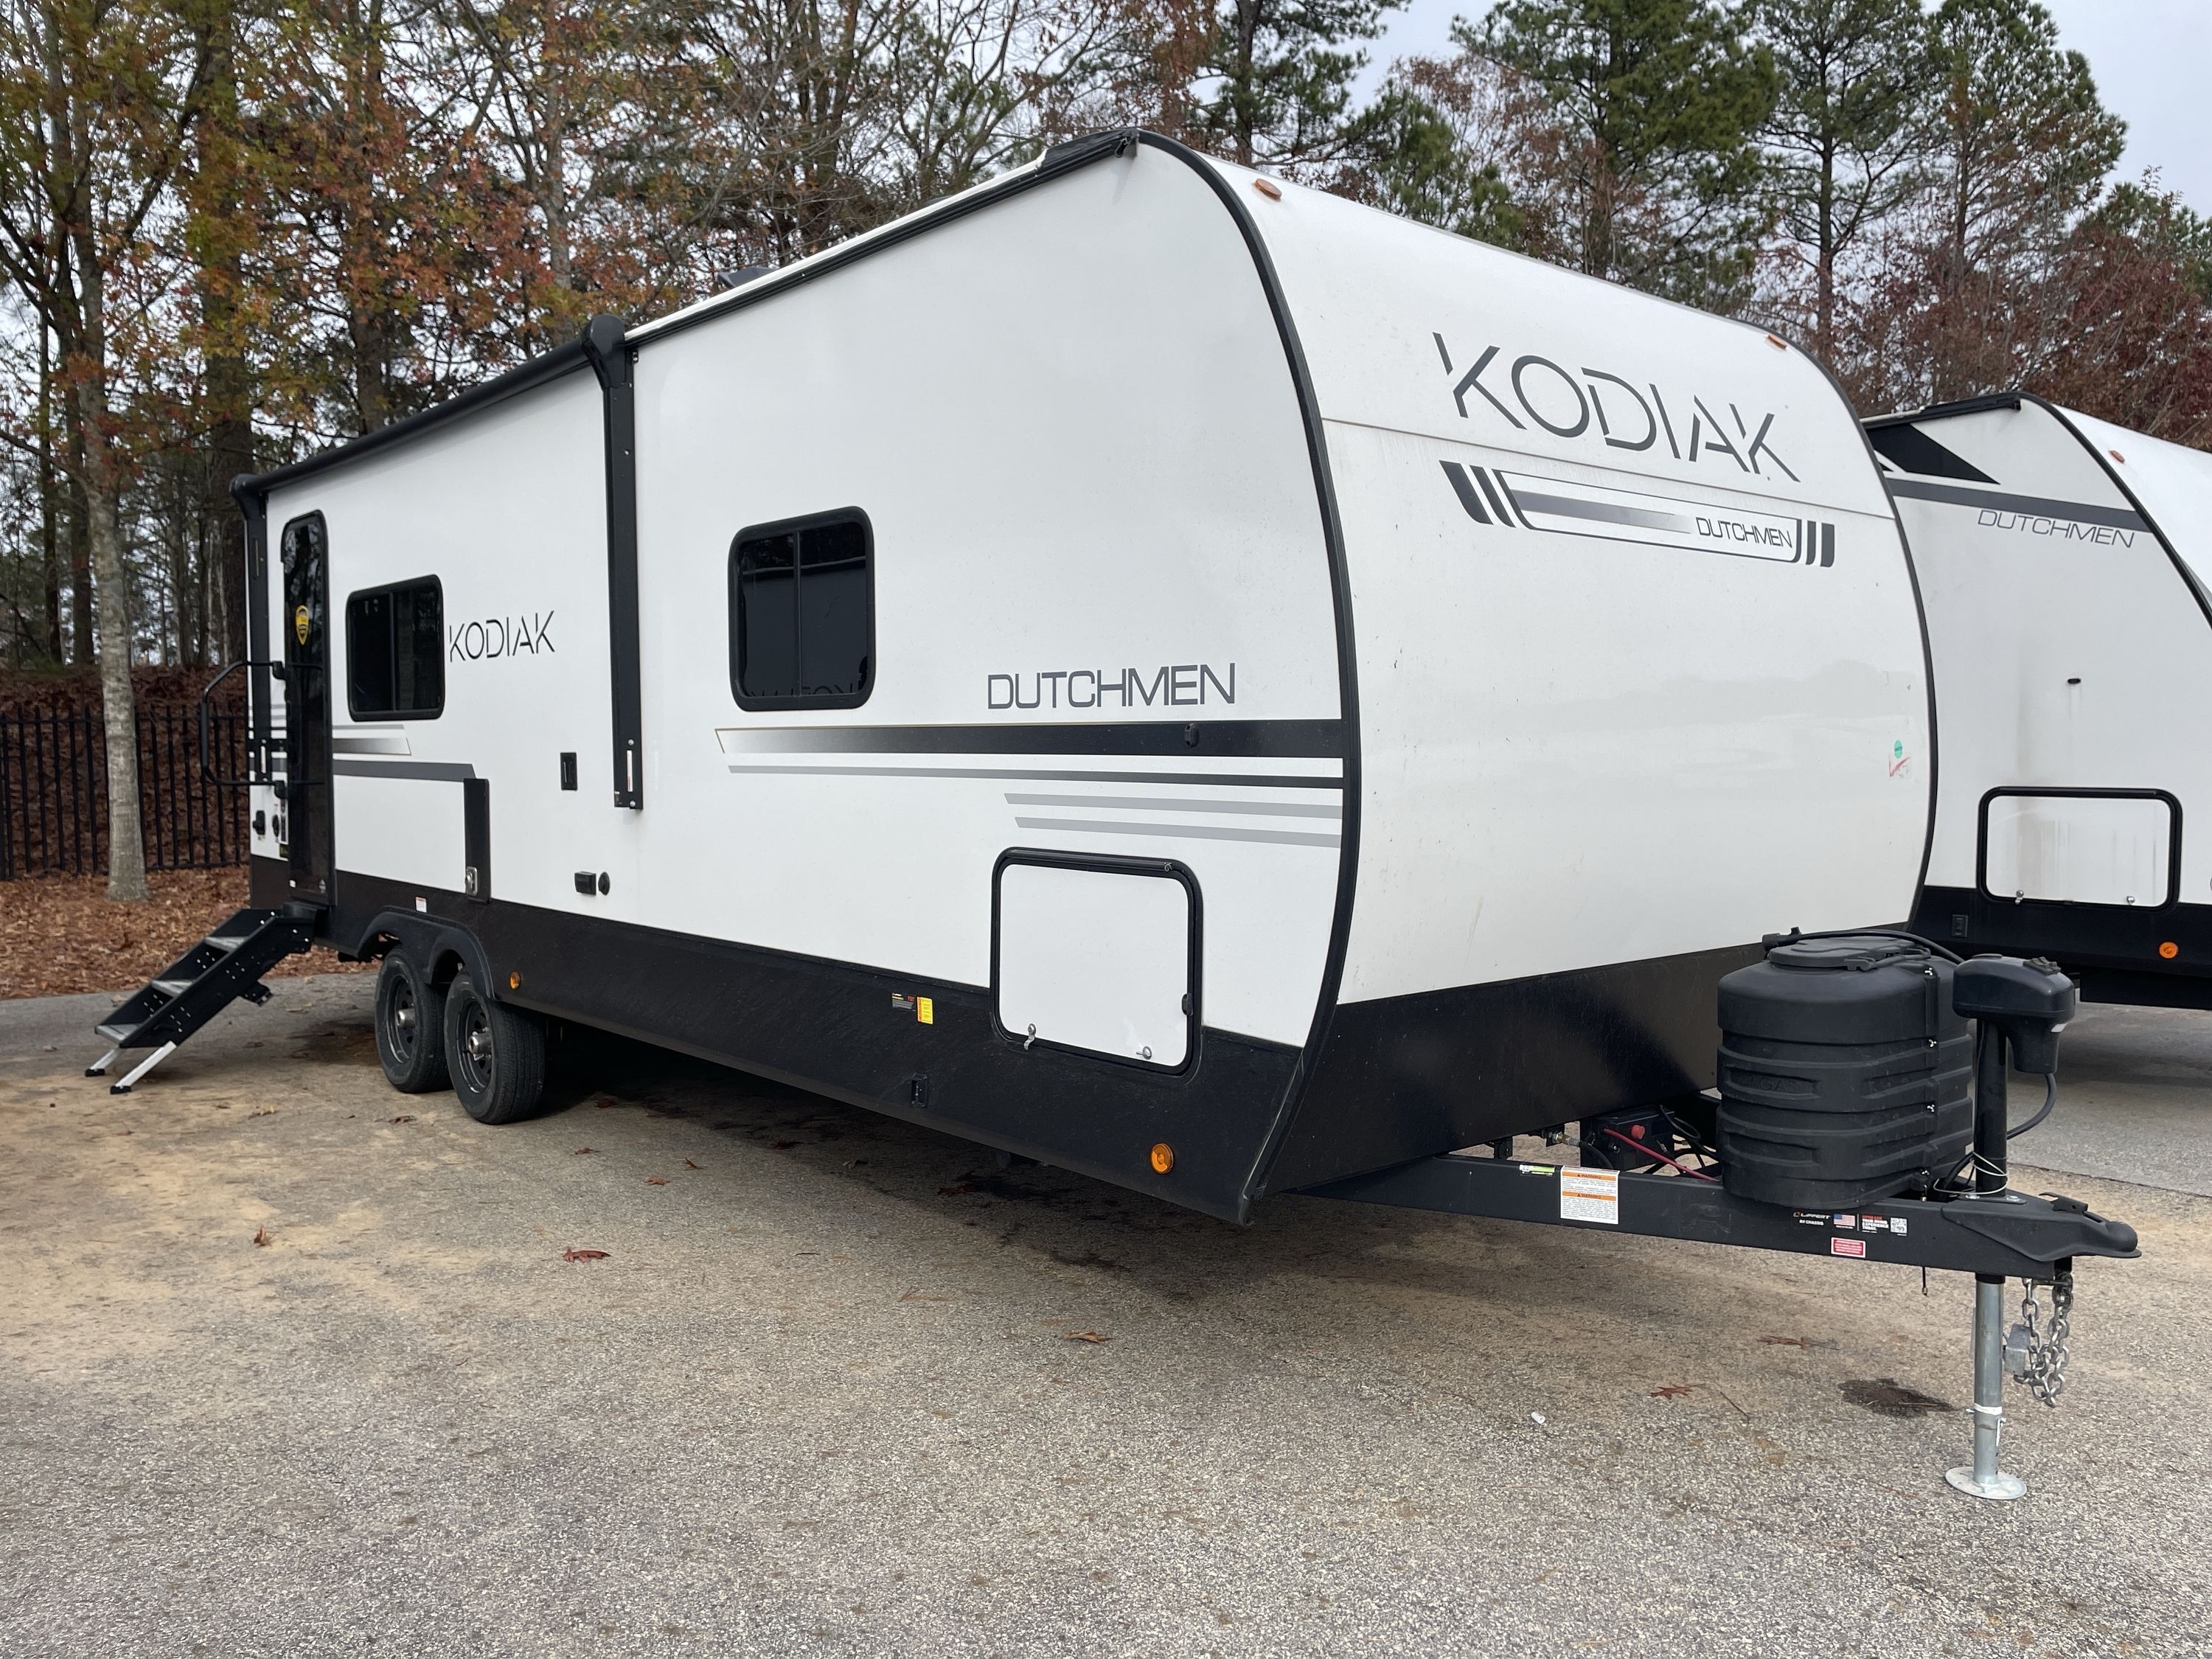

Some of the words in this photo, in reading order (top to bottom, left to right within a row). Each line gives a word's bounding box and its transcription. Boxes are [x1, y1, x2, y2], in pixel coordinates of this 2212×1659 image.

[1432, 332, 1801, 483] KODIAK
[1695, 517, 1792, 549] DUTCHMEN
[1978, 509, 2135, 549] DUTCHMEN
[449, 611, 555, 662] KODIAK
[987, 662, 1236, 709] DUTCHMEN
[1759, 1077, 1797, 1093] GAS
